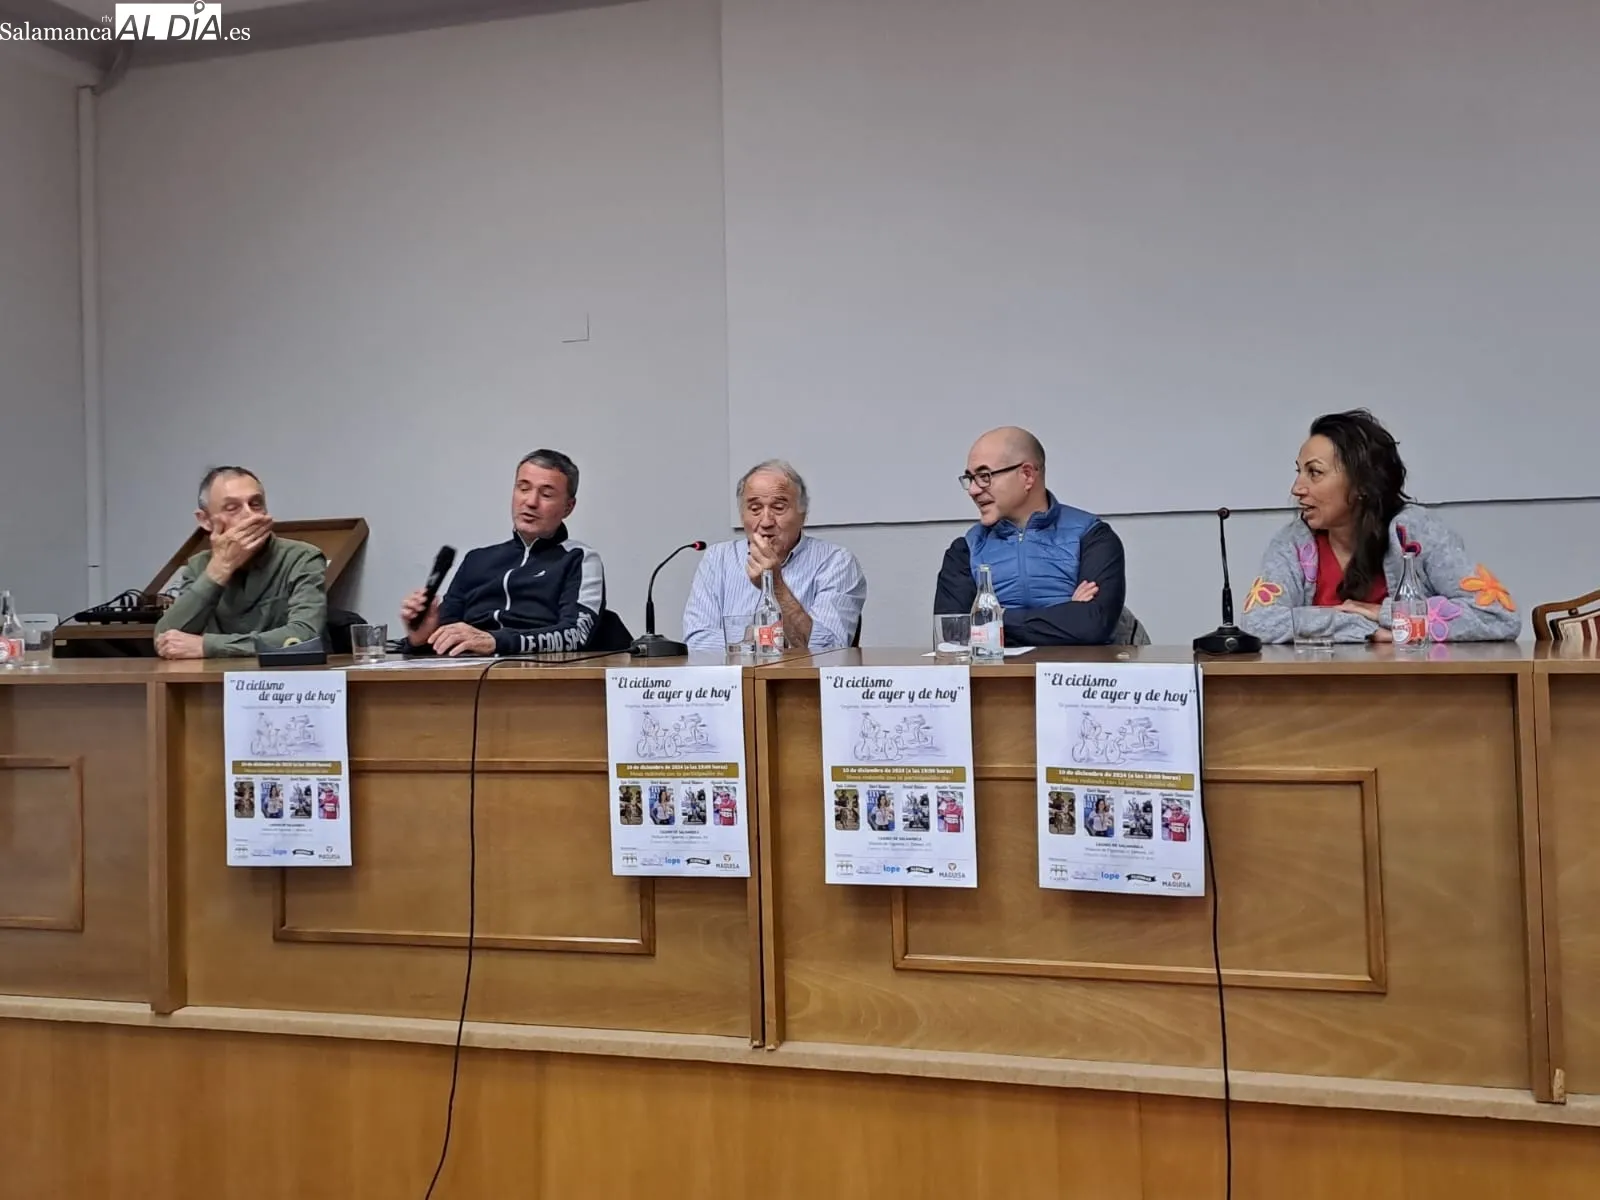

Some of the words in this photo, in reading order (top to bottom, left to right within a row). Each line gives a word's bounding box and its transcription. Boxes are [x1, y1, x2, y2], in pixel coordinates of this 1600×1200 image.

[520, 635, 536, 652] LE
[246, 680, 285, 690] ciclismo
[630, 677, 671, 688] ciclismo
[846, 676, 893, 688] ciclismo
[1066, 674, 1117, 687] ciclismo
[258, 691, 270, 700] de
[272, 693, 293, 704] ayer
[297, 693, 302, 704] y
[304, 691, 316, 700] de
[643, 689, 655, 699] de
[658, 690, 683, 702] ayer
[686, 690, 692, 702] y
[695, 688, 708, 698] de
[862, 688, 876, 700] de
[878, 691, 905, 703] ayer
[908, 691, 915, 703] y
[918, 688, 932, 699] de
[1083, 688, 1099, 699] de
[1101, 691, 1131, 704] ayer
[1134, 692, 1142, 704] y
[1145, 689, 1161, 701] de
